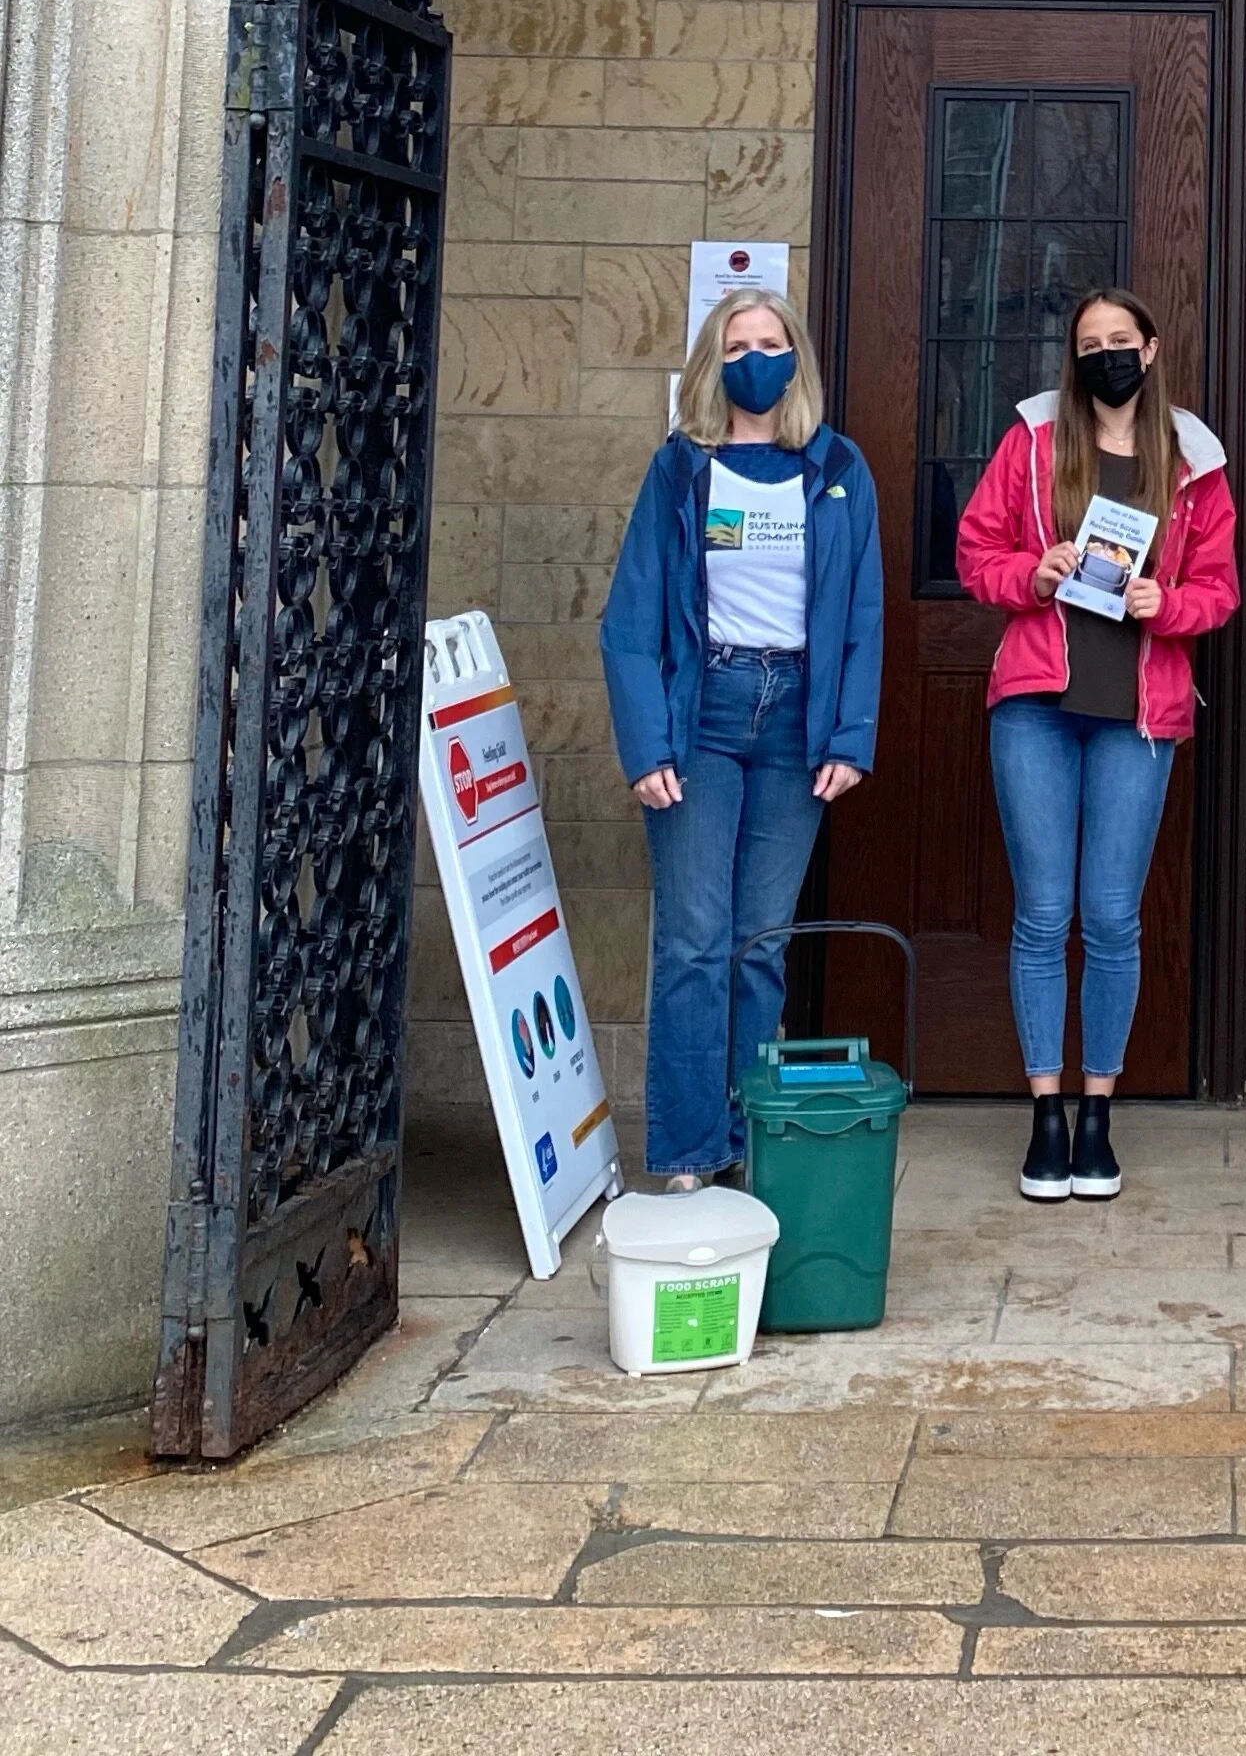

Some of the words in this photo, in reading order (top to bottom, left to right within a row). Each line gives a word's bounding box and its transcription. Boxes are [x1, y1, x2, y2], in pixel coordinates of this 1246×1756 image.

[748, 511, 771, 519] RYE
[454, 769, 473, 794] STOP
[659, 1282, 692, 1293] FOOD
[695, 1276, 737, 1290] SCRAPS
